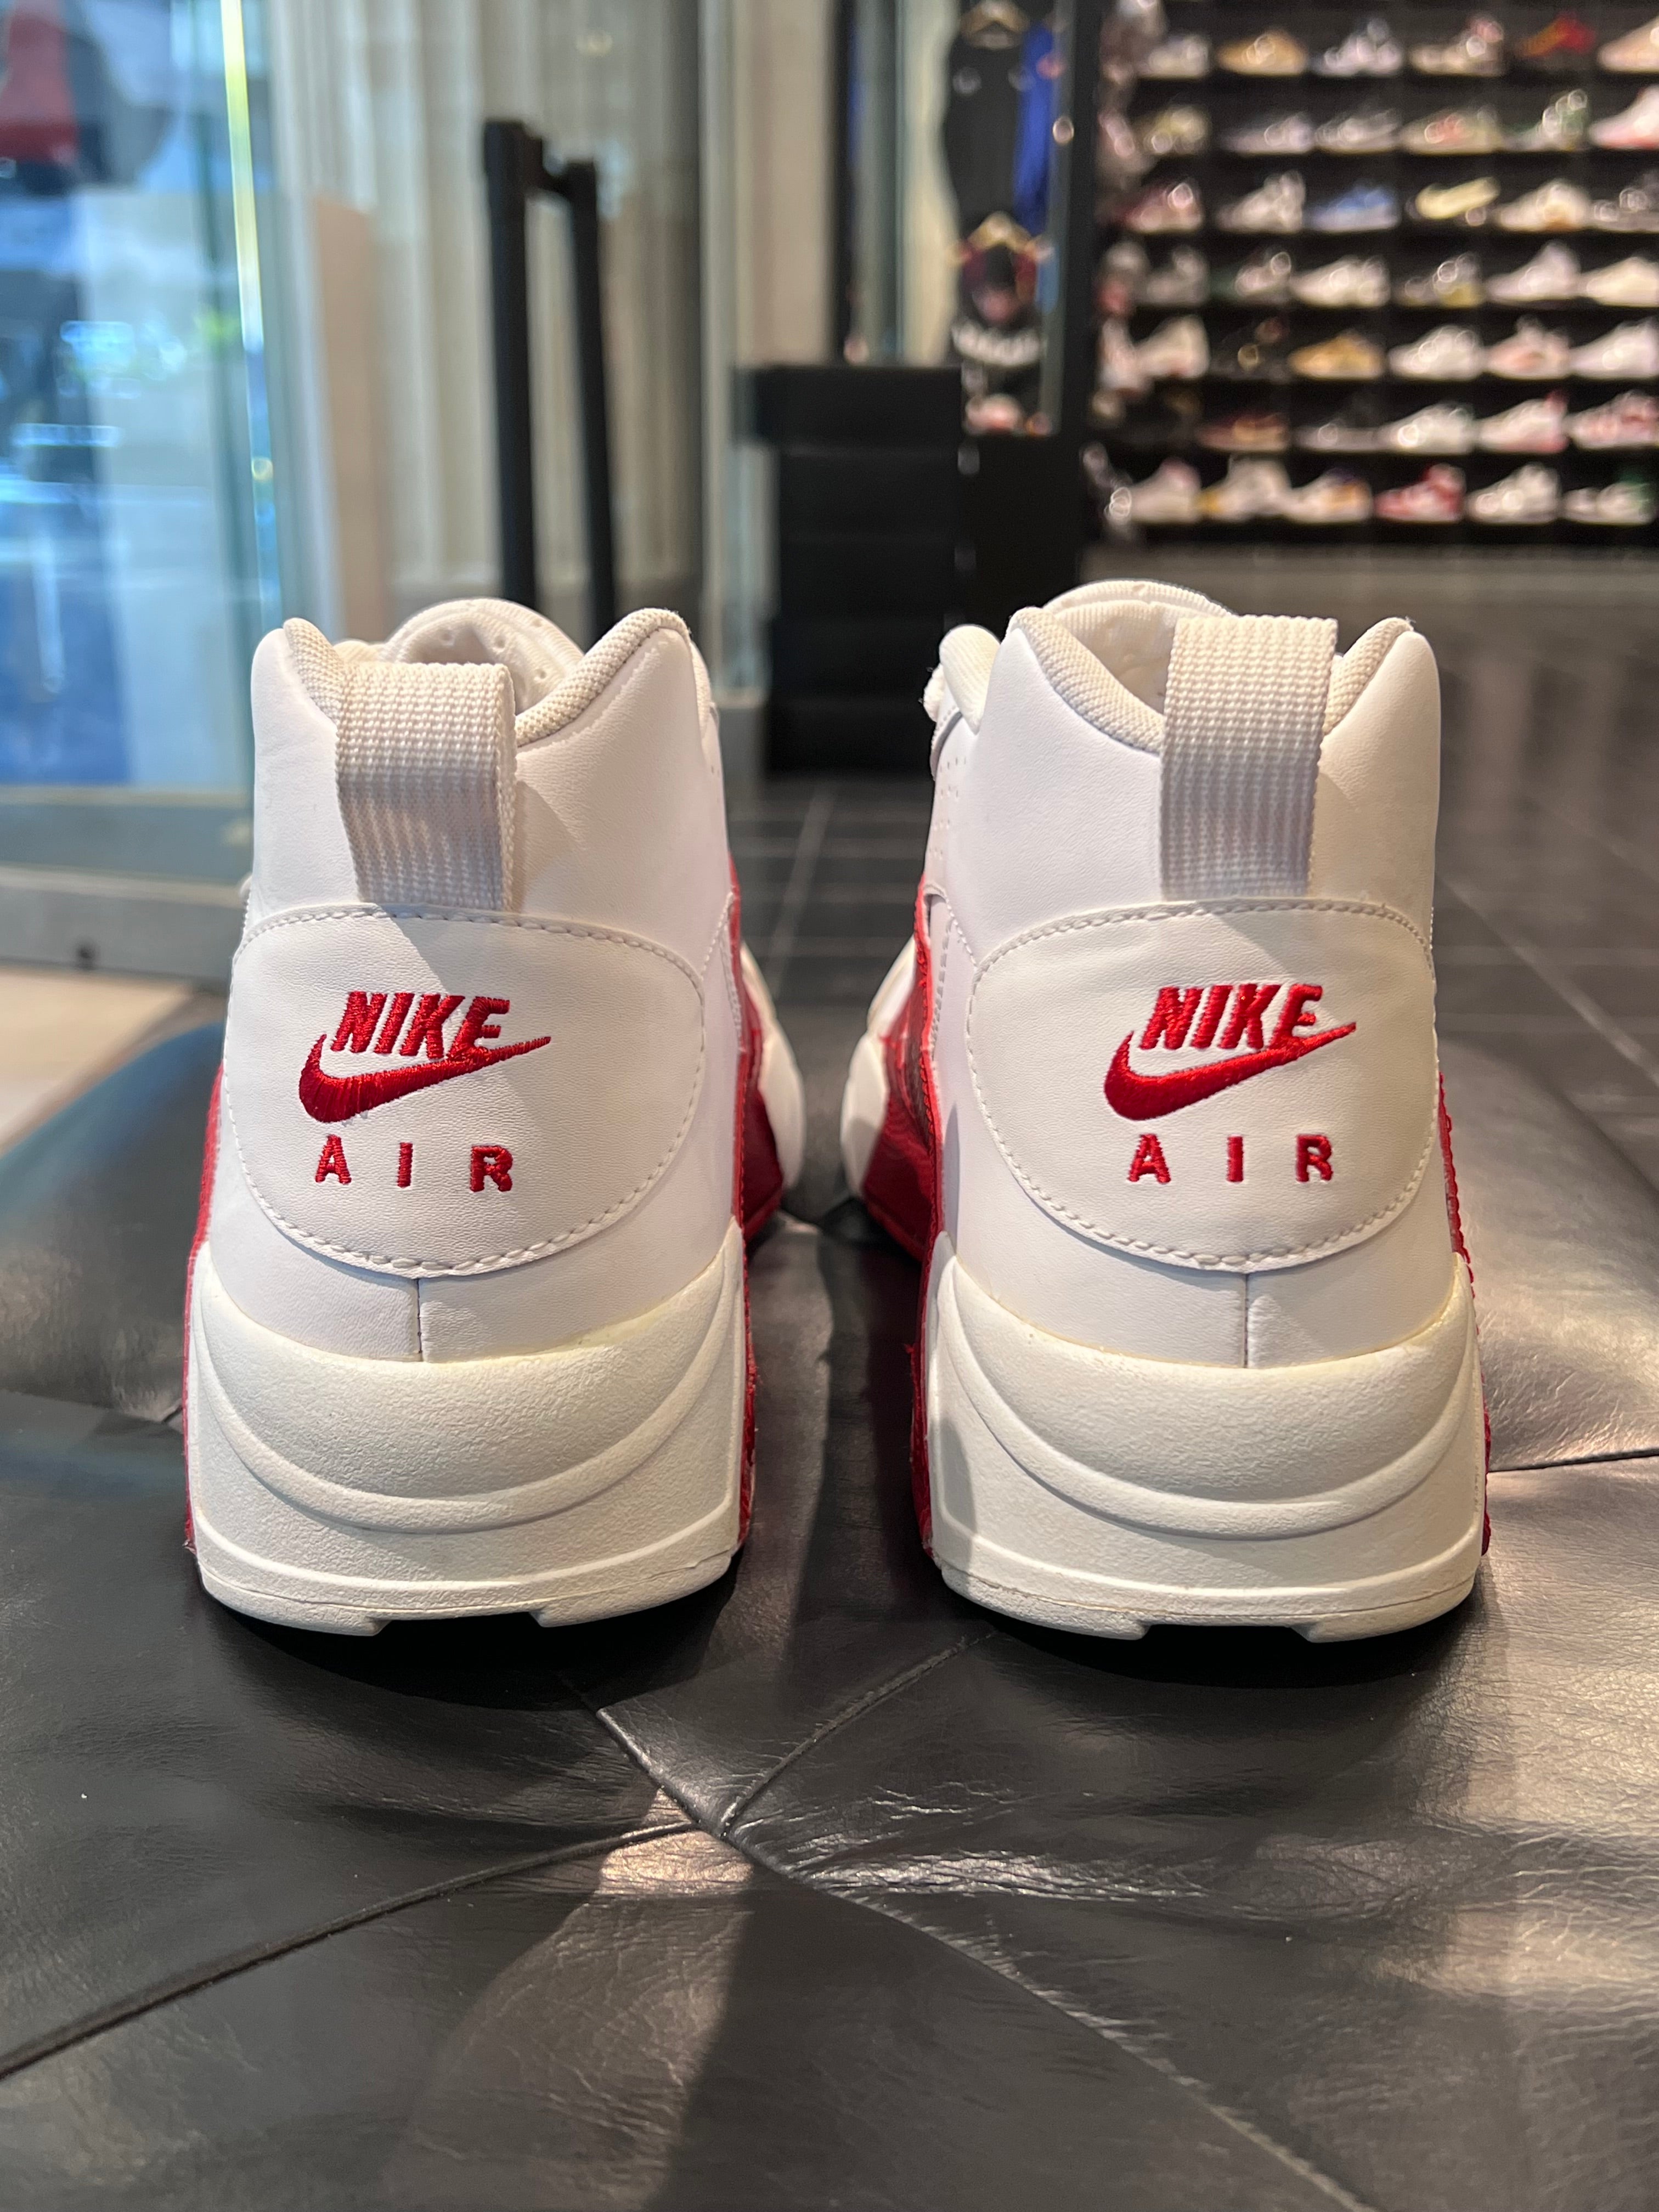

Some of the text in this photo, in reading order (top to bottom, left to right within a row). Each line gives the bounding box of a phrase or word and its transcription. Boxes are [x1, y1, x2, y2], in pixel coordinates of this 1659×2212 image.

[331, 991, 510, 1060] NIKE
[1139, 984, 1323, 1050] NIKE
[315, 1135, 514, 1193] AIR
[1127, 1134, 1334, 1183] AIR
